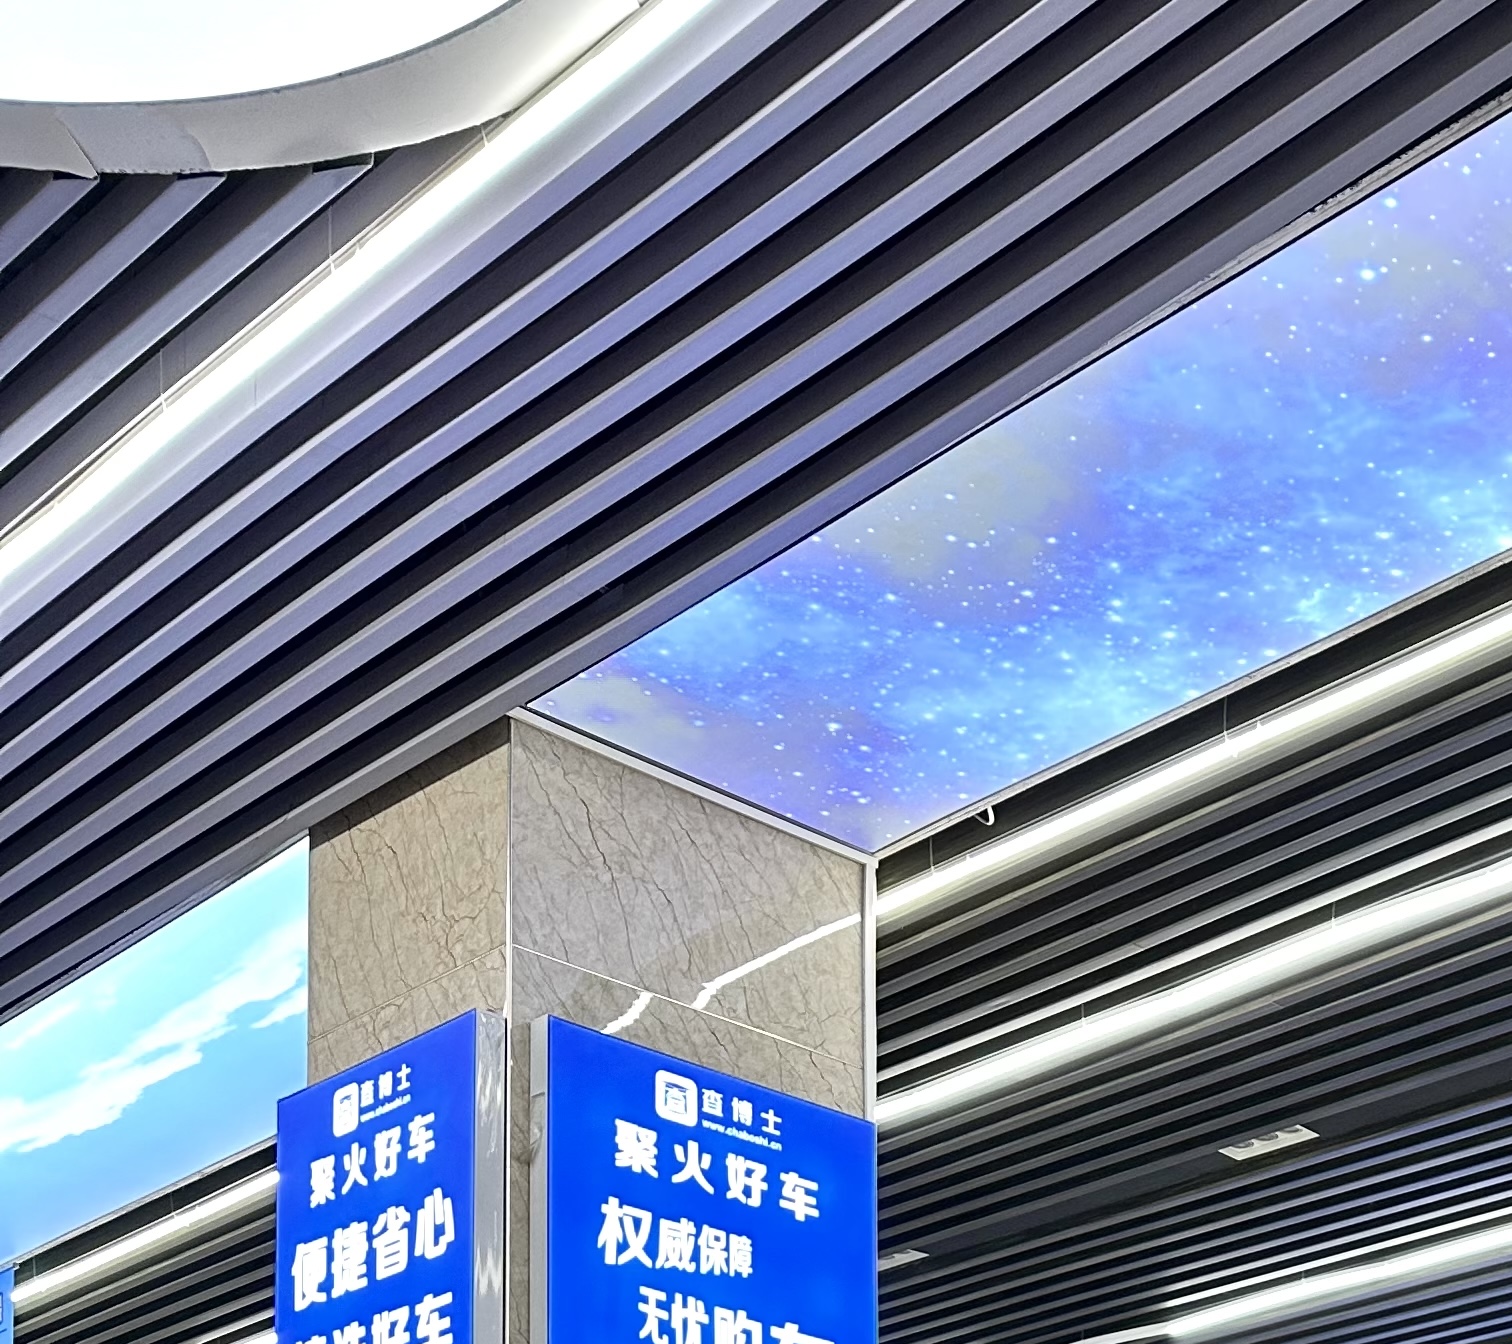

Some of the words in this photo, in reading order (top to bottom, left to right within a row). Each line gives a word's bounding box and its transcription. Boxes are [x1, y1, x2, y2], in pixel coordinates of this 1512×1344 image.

[360, 1063, 411, 1107] 查博士
[702, 1088, 782, 1136] 查博士
[310, 1112, 435, 1208] 聚火好车
[615, 1118, 820, 1222] 聚火好车
[702, 1119, 782, 1151] www.chaboshi.cn
[291, 1187, 455, 1312] 便捷省心
[597, 1195, 753, 1278] 权威保障
